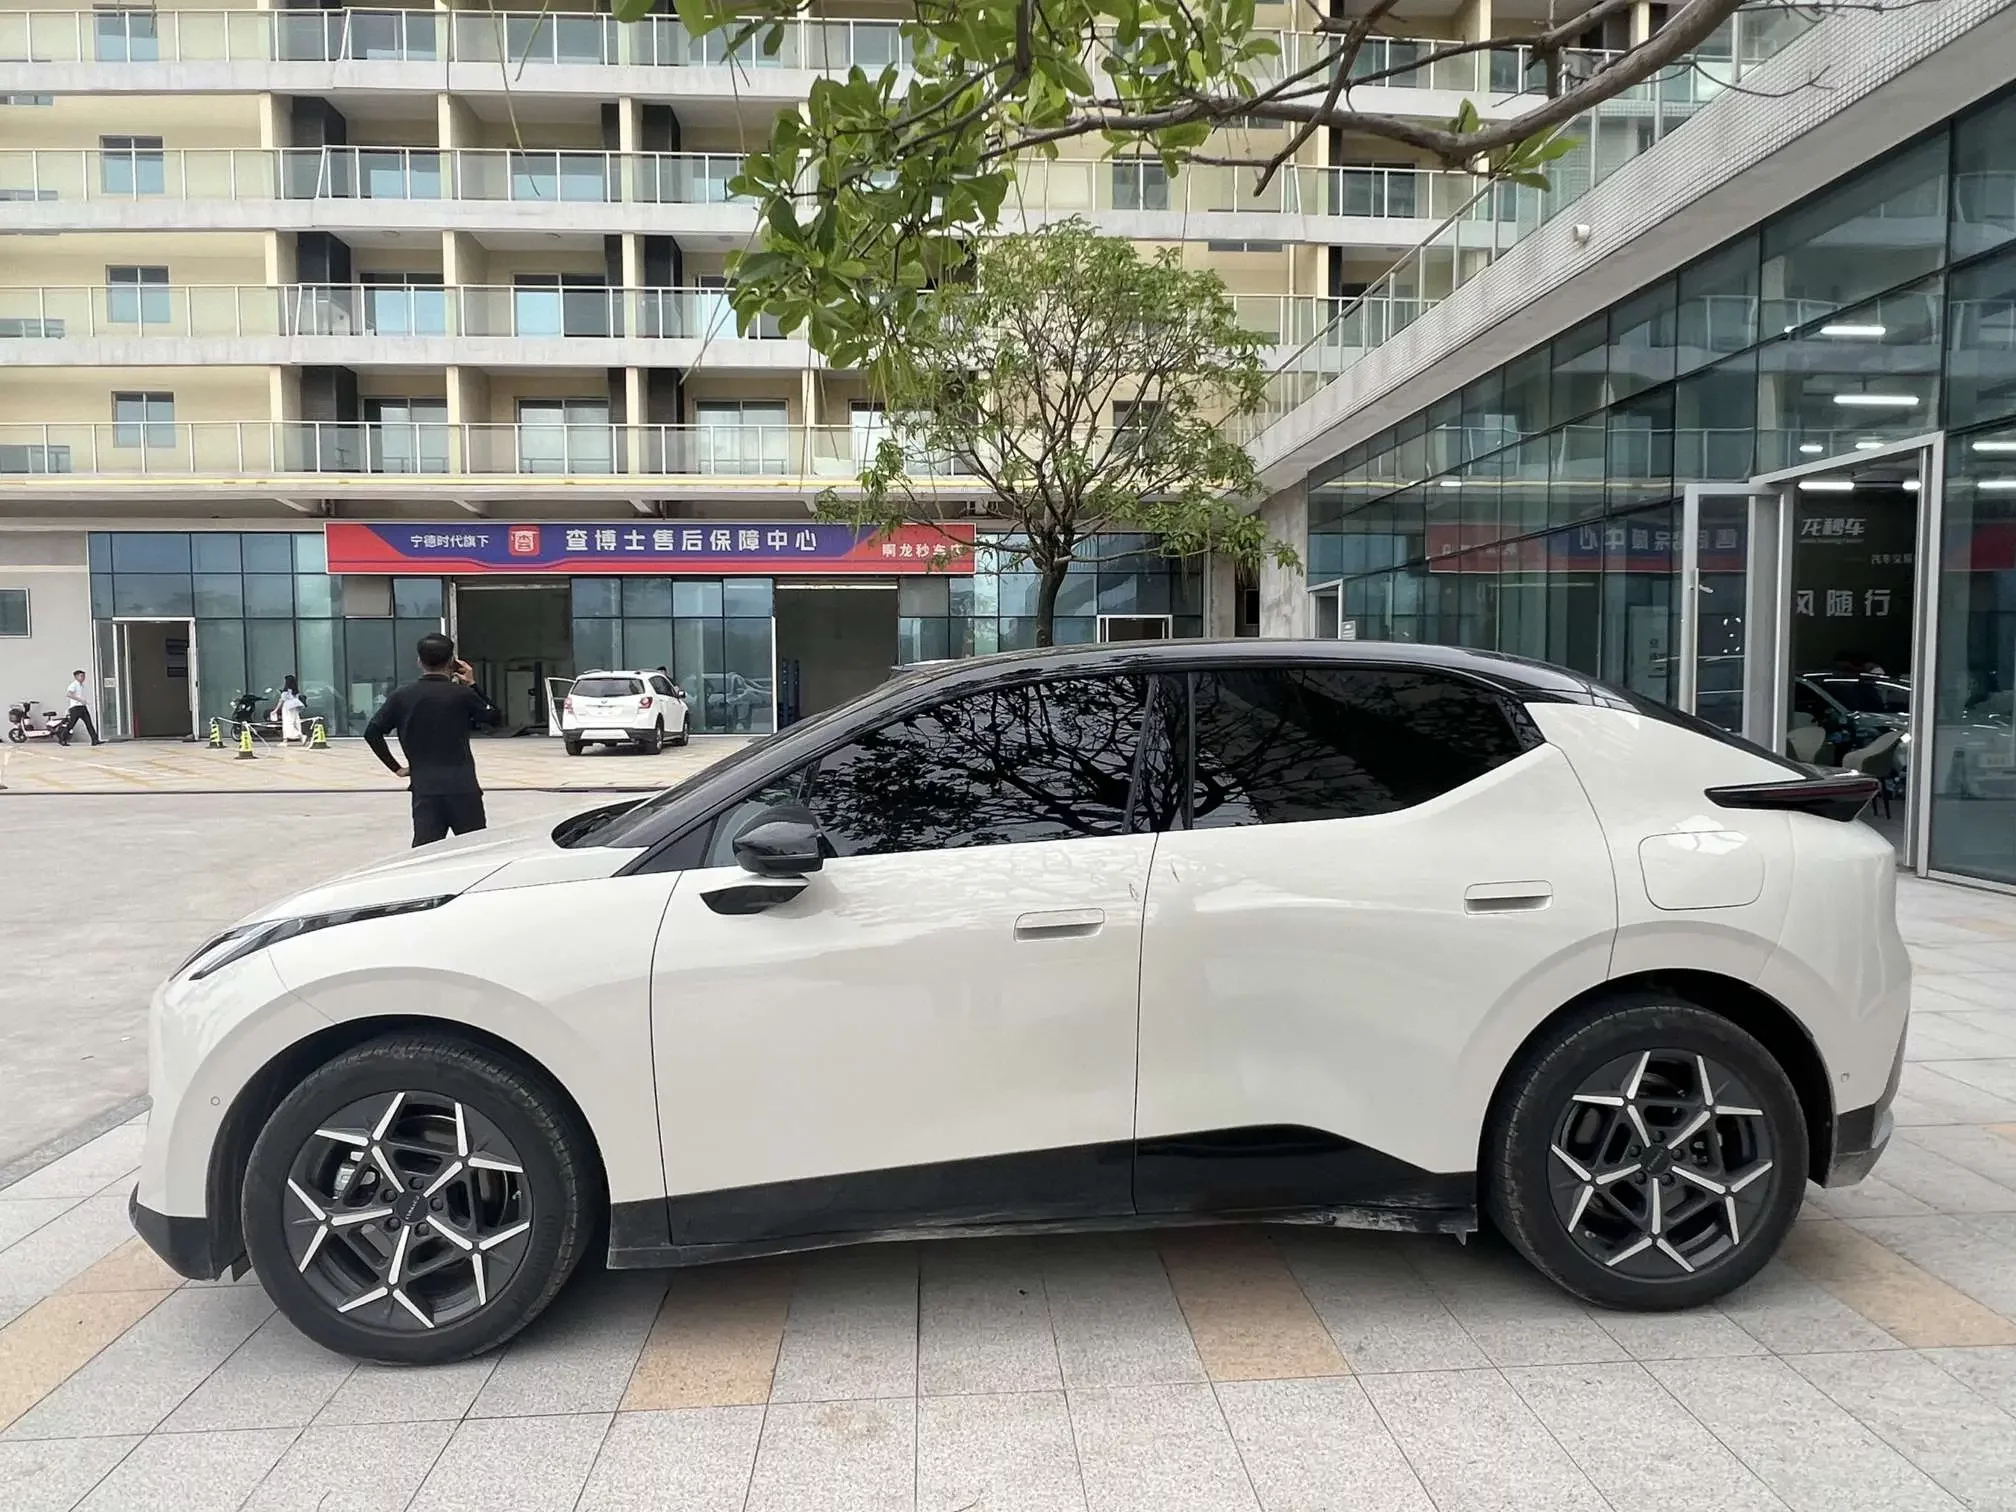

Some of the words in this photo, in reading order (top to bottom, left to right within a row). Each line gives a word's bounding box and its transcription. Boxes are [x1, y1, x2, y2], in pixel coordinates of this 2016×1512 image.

[411, 534, 489, 548] 宁德时代旗下
[566, 529, 817, 551] 查博士售后保障中心
